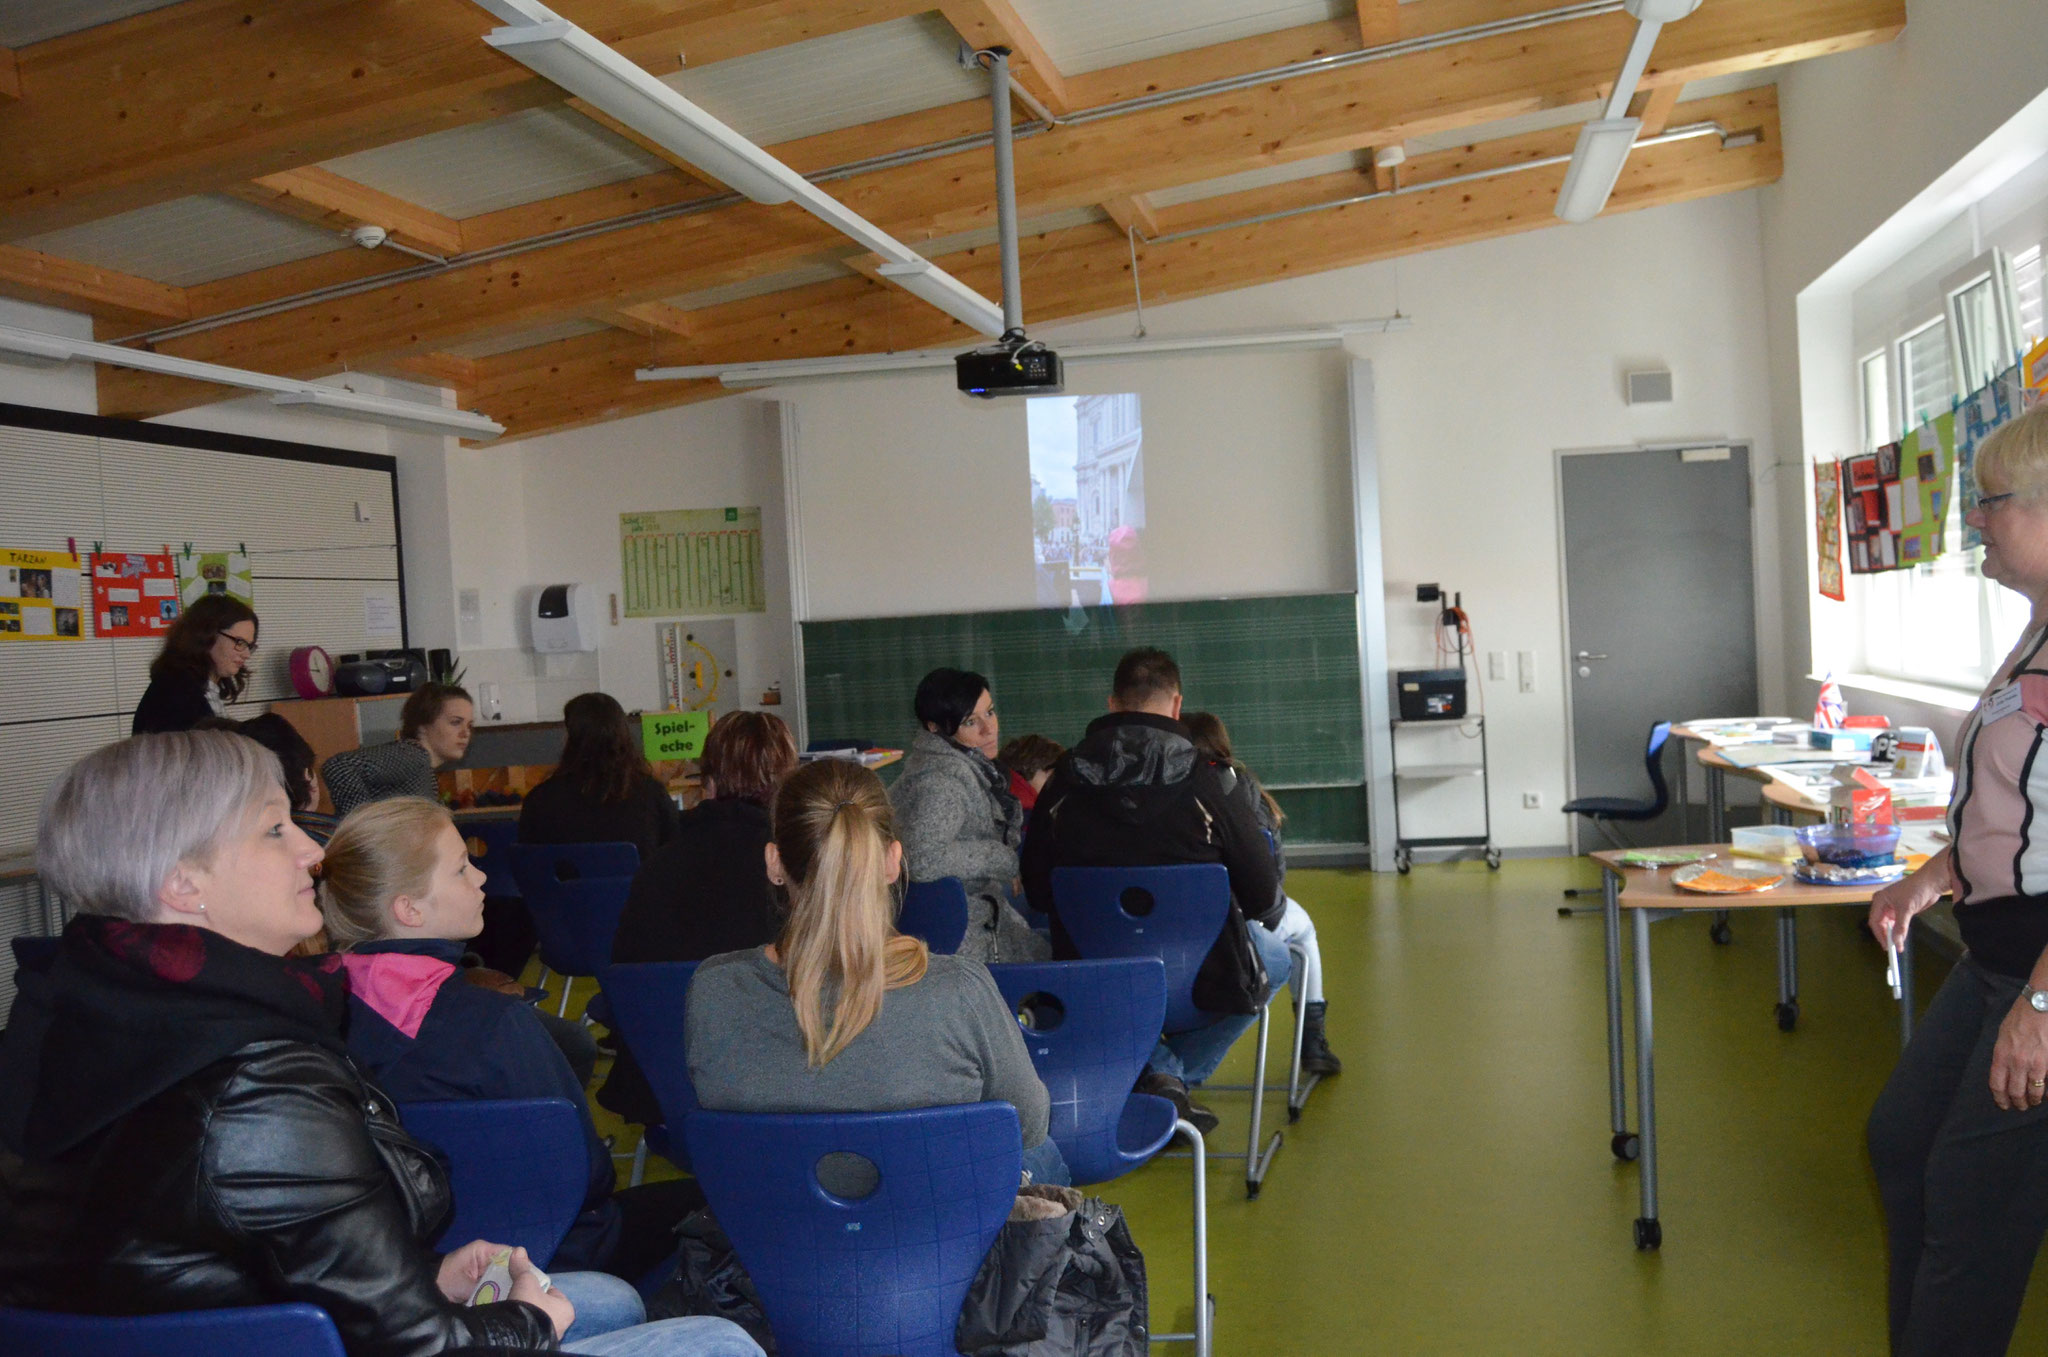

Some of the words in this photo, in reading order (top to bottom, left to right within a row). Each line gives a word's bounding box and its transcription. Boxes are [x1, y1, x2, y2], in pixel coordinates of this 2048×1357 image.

[9, 552, 47, 563] TARZAN
[655, 721, 695, 736] Spiel-
[660, 740, 693, 752] ecke
